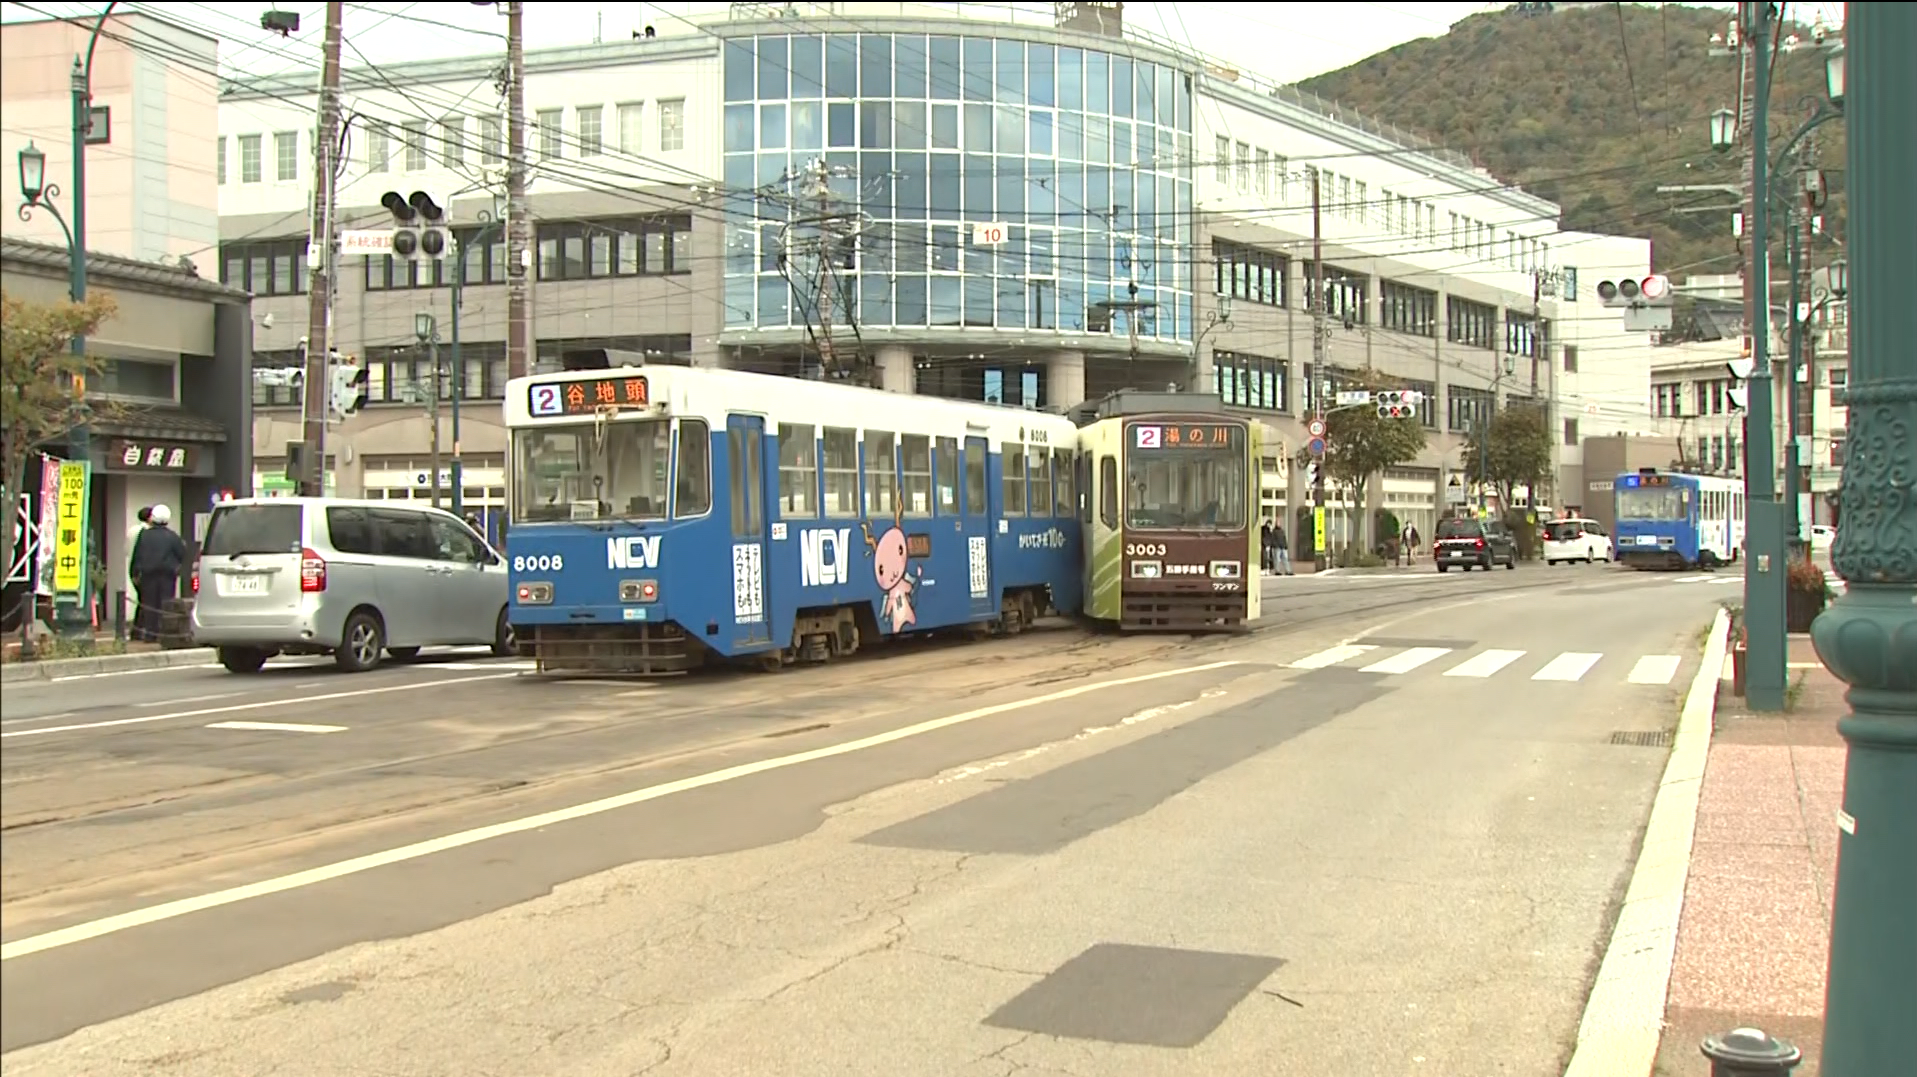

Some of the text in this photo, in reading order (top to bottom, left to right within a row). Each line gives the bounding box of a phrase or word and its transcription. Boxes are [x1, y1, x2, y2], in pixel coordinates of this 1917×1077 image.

[983, 228, 1001, 243] 10
[538, 379, 646, 411] 2 谷地頭
[1141, 427, 1228, 445] 2 湯の川
[65, 478, 83, 490] 100
[61, 502, 78, 572] 工事中
[607, 536, 662, 569] NCV
[800, 528, 851, 587] NCV
[1126, 544, 1167, 556] 3003
[513, 555, 563, 572] 8008
[736, 547, 745, 608] スマホも
[753, 547, 761, 607] テレビも
[1212, 582, 1240, 591] ワンマン
